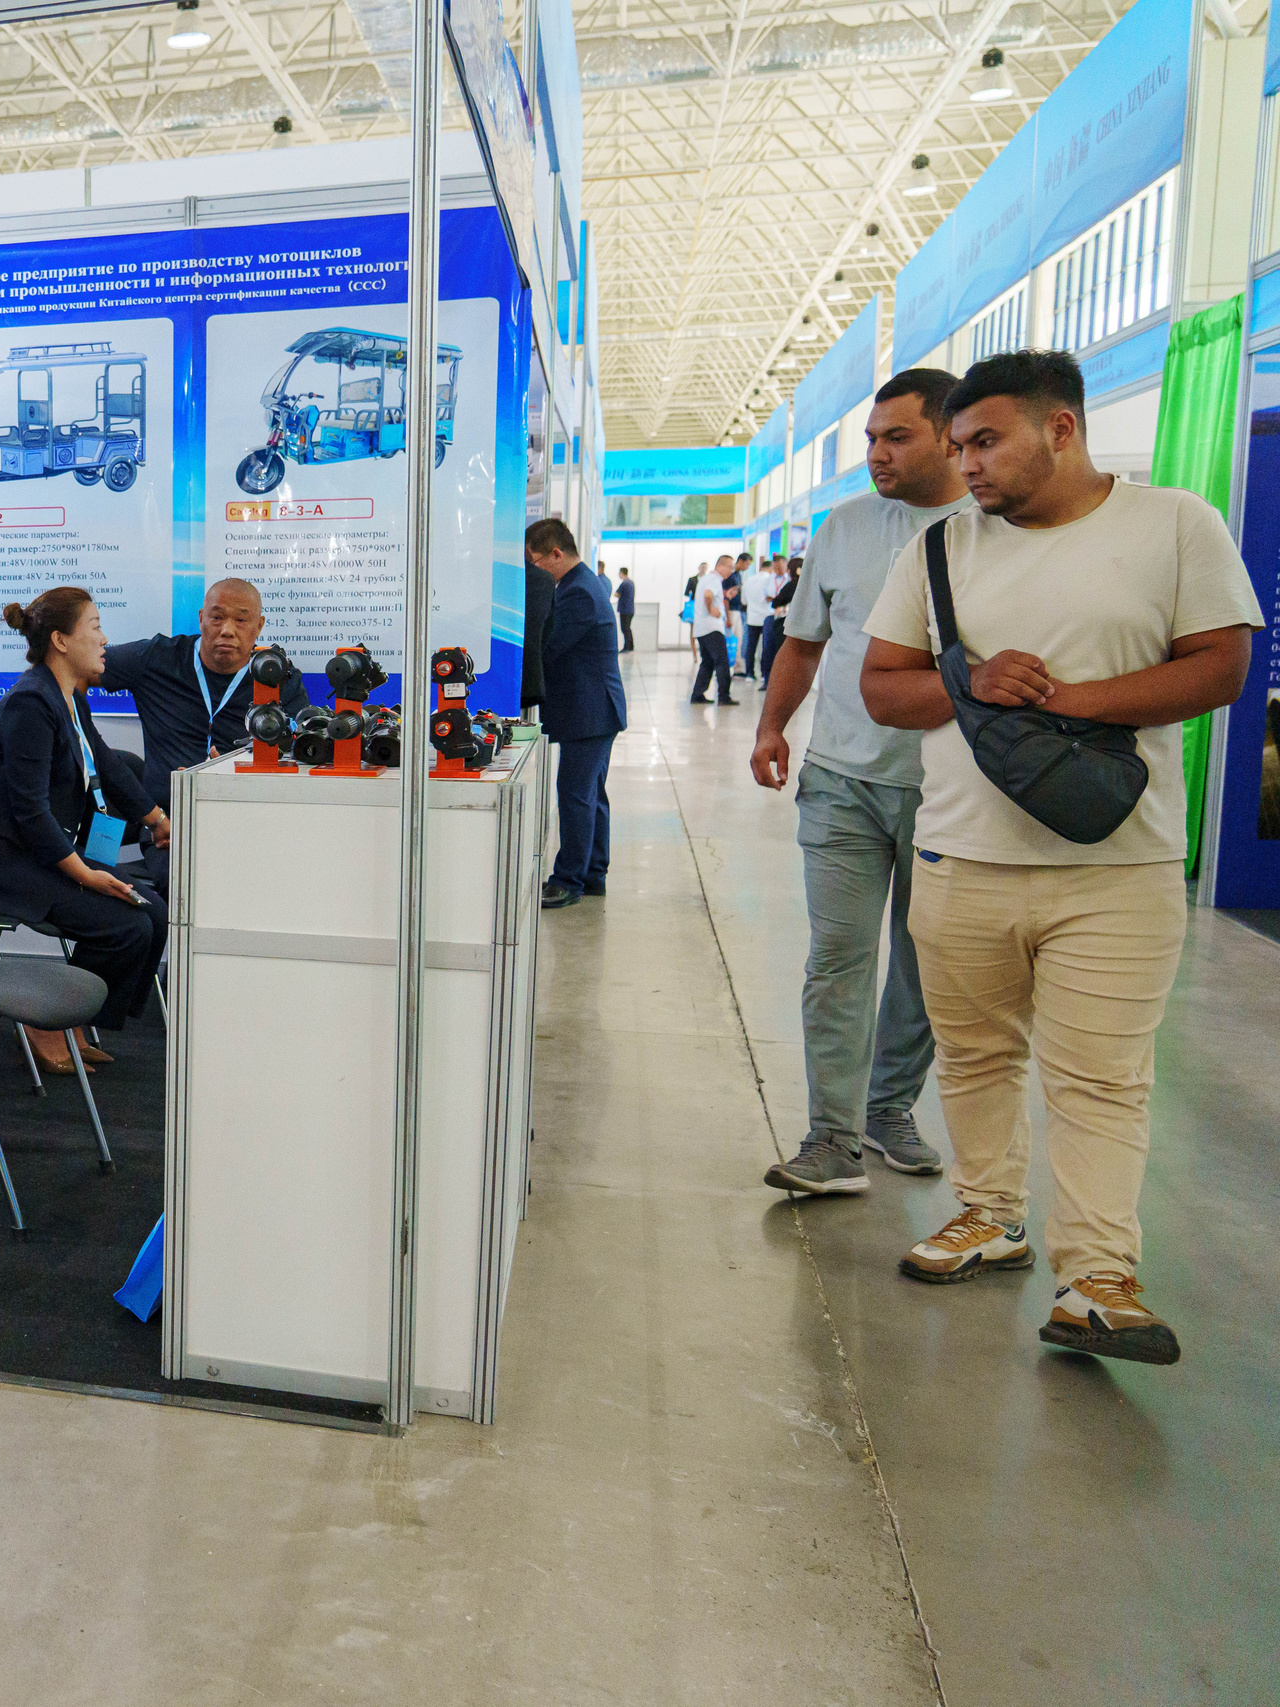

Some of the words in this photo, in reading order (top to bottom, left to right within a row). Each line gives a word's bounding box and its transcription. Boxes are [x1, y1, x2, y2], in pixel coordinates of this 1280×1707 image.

[13, 264, 114, 283] предприятие
[118, 262, 137, 274] по
[142, 254, 253, 275] производству
[258, 246, 362, 264] мотоциклов
[10, 277, 150, 299] промышленности
[155, 276, 165, 288] и
[170, 266, 321, 289] информационных
[39, 301, 96, 314] продукции
[99, 295, 162, 308] Китайского
[165, 293, 203, 304] центра
[205, 288, 287, 302] сертификации
[290, 285, 341, 296] качества
[30, 531, 80, 541] параметры:
[225, 532, 272, 541] Основные
[274, 532, 332, 540] технические
[225, 561, 265, 570] Система
[45, 572, 55, 580] 24
[57, 572, 87, 582] трубки
[349, 574, 360, 582] 24
[364, 574, 396, 585] трубки
[95, 585, 124, 594] связи)
[289, 604, 366, 614] характеристики
[296, 618, 327, 628] Заднее
[329, 618, 393, 627] колесо375-12
[267, 632, 344, 644] амортизации:43
[347, 632, 380, 644] трубки
